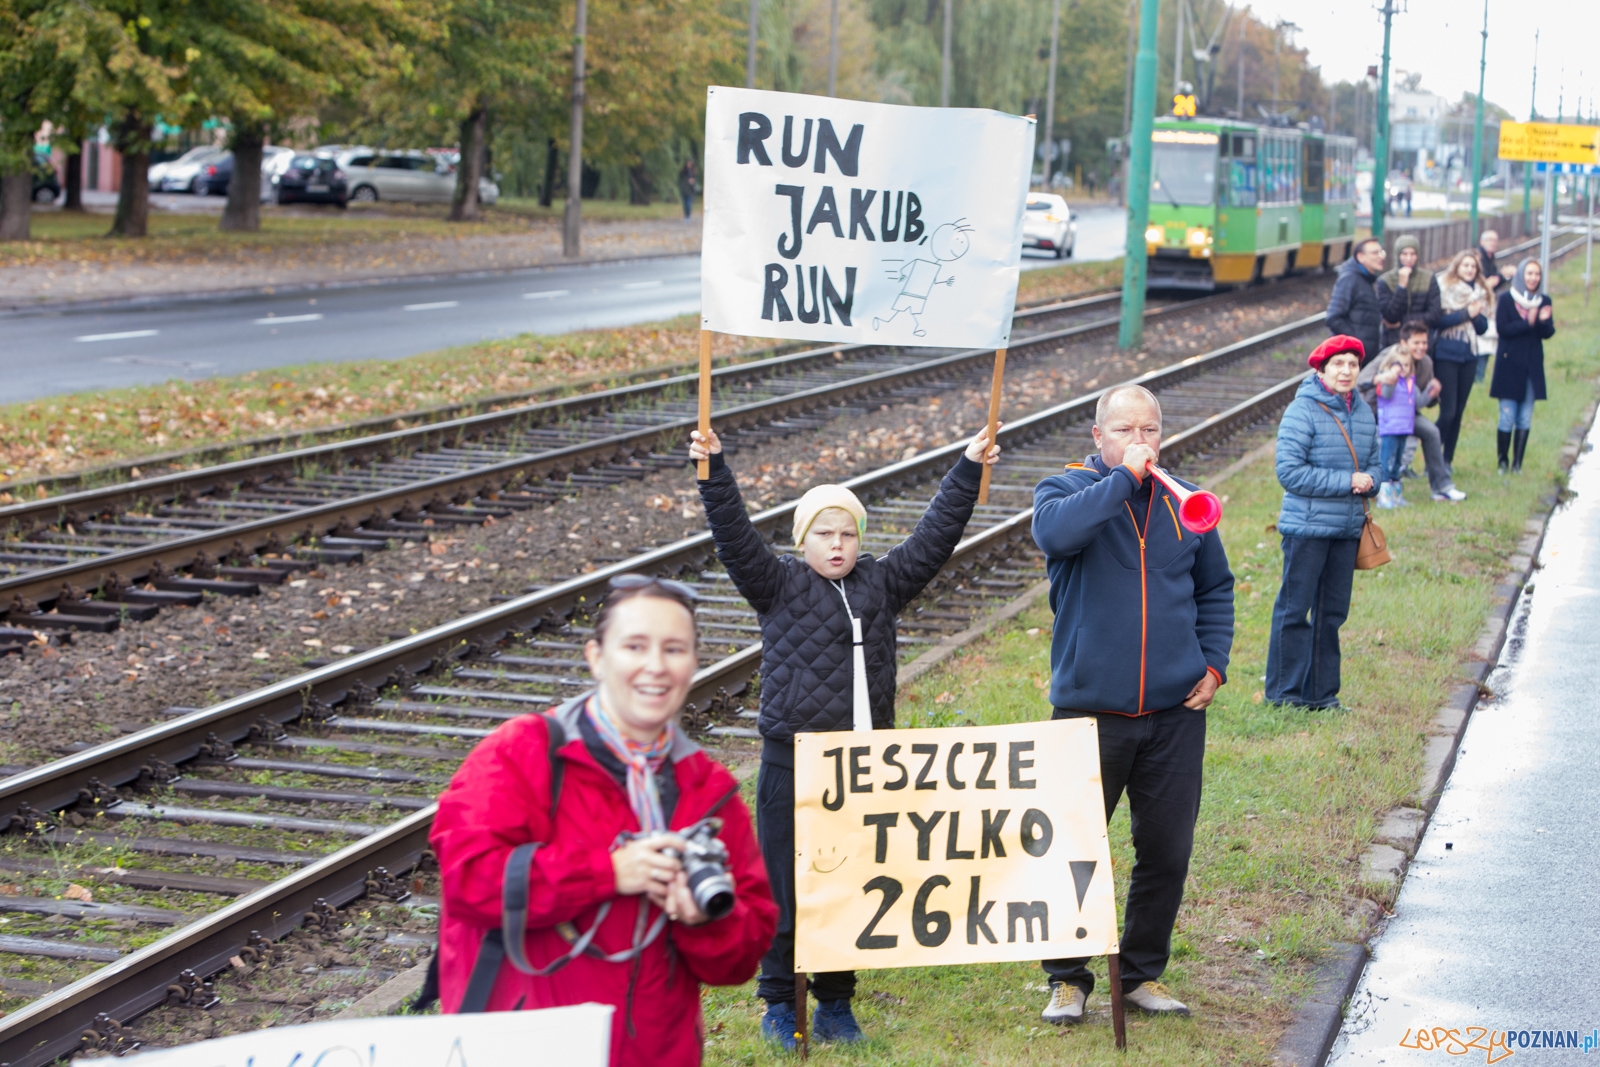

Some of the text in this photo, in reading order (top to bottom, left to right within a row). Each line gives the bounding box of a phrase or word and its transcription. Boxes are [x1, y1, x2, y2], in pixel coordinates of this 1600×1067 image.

[736, 111, 864, 177] RUN
[775, 184, 928, 259] JAKUB,
[761, 263, 858, 327] RUN
[822, 740, 1037, 812] JESZCZE
[863, 808, 1053, 864] TYLKO
